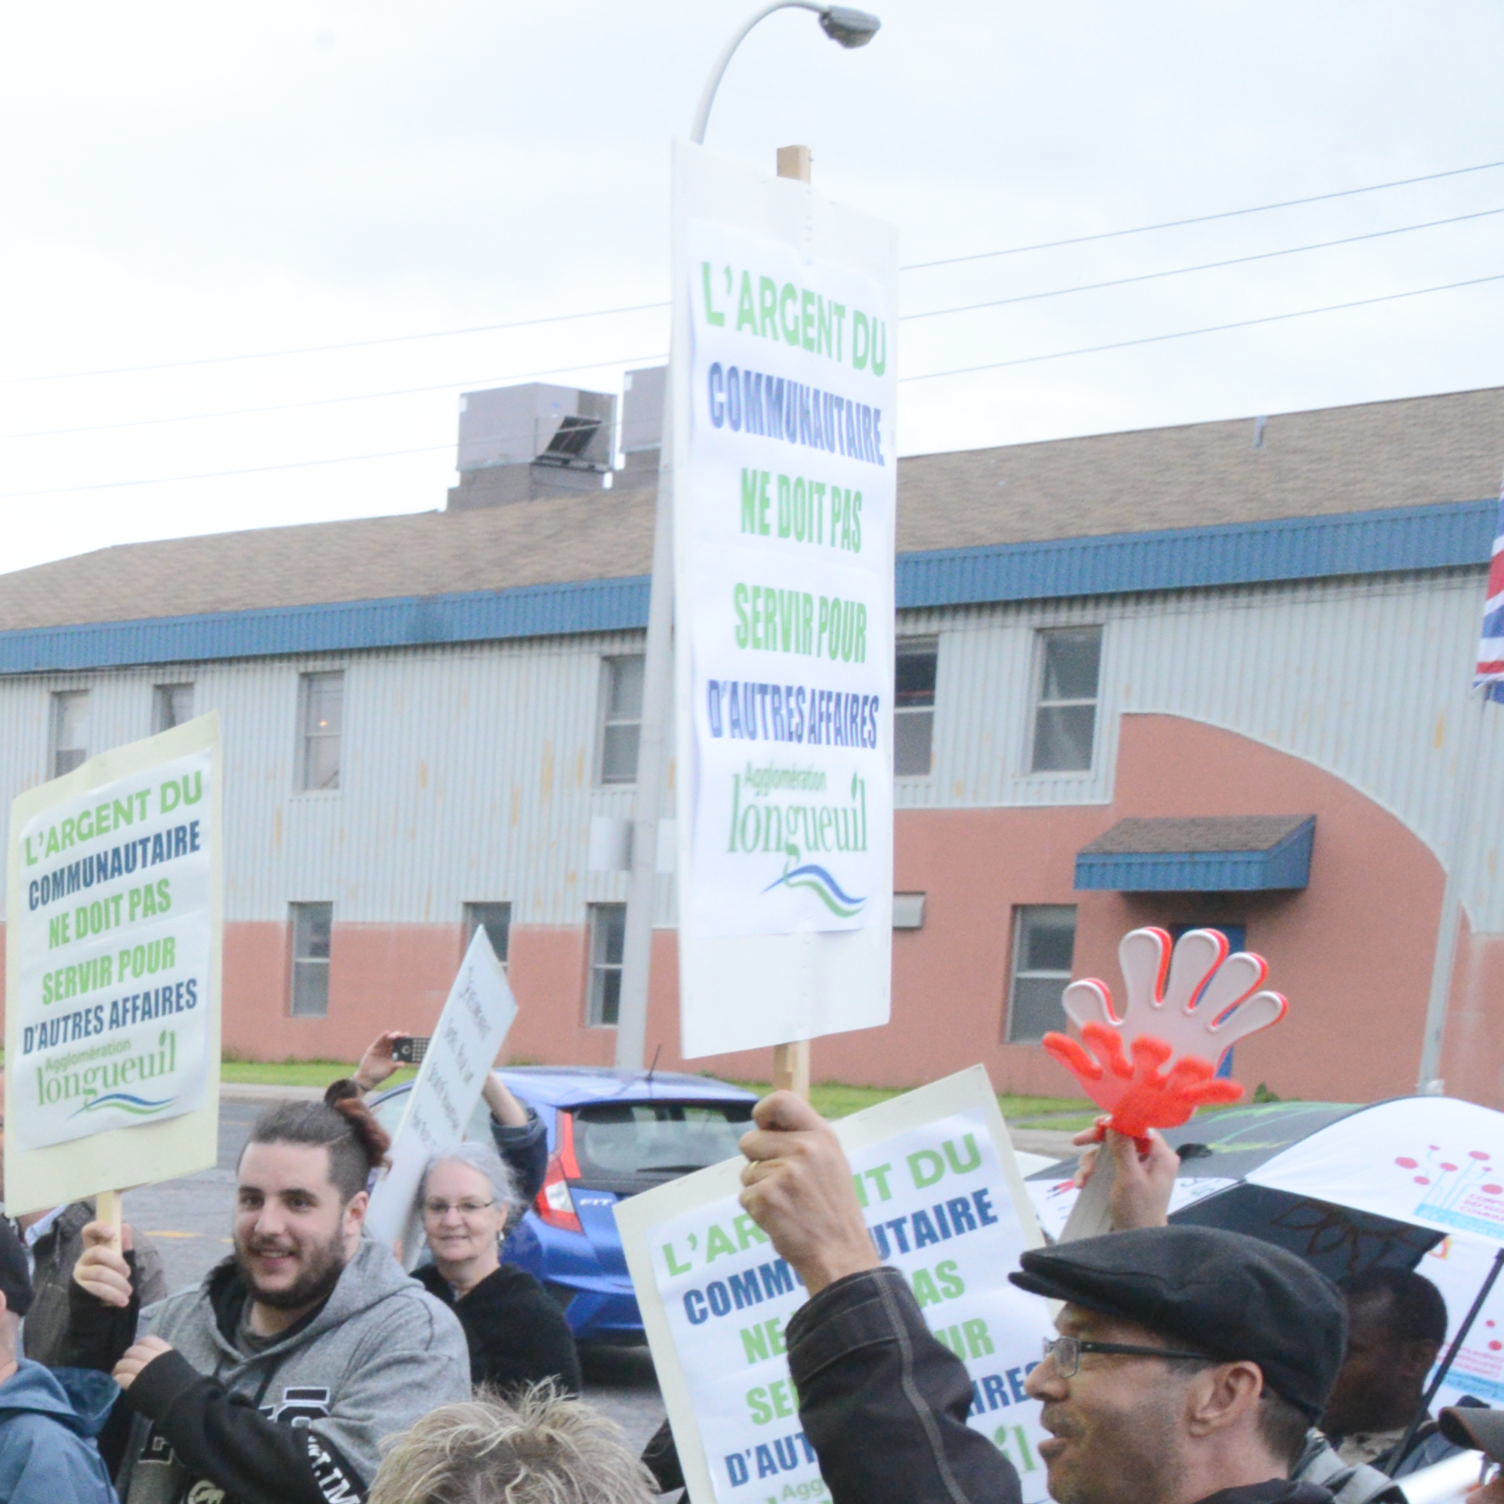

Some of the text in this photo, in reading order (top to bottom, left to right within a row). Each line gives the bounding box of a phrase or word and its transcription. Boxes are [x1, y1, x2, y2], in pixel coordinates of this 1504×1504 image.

[701, 261, 887, 377] L'ARGENT DU
[708, 361, 886, 467] COMMUNAUTAIRE
[741, 467, 863, 554] NE DOIT PAS
[733, 582, 868, 664] SERVIR POUR
[707, 678, 880, 750] D'AUTRES AFFAIRES
[25, 770, 203, 867] L'ARGENT DU
[727, 770, 868, 878] longueuil
[29, 819, 201, 912] COMMUNAUTAIRE
[49, 878, 173, 949] NE DOIT PAS
[43, 936, 176, 1006] SERVIR POUR
[23, 977, 199, 1056] D'AUTRES AFFAIRES
[45, 1037, 132, 1073] Agglomération
[36, 1028, 177, 1112] longueuil
[906, 1132, 983, 1191] DU
